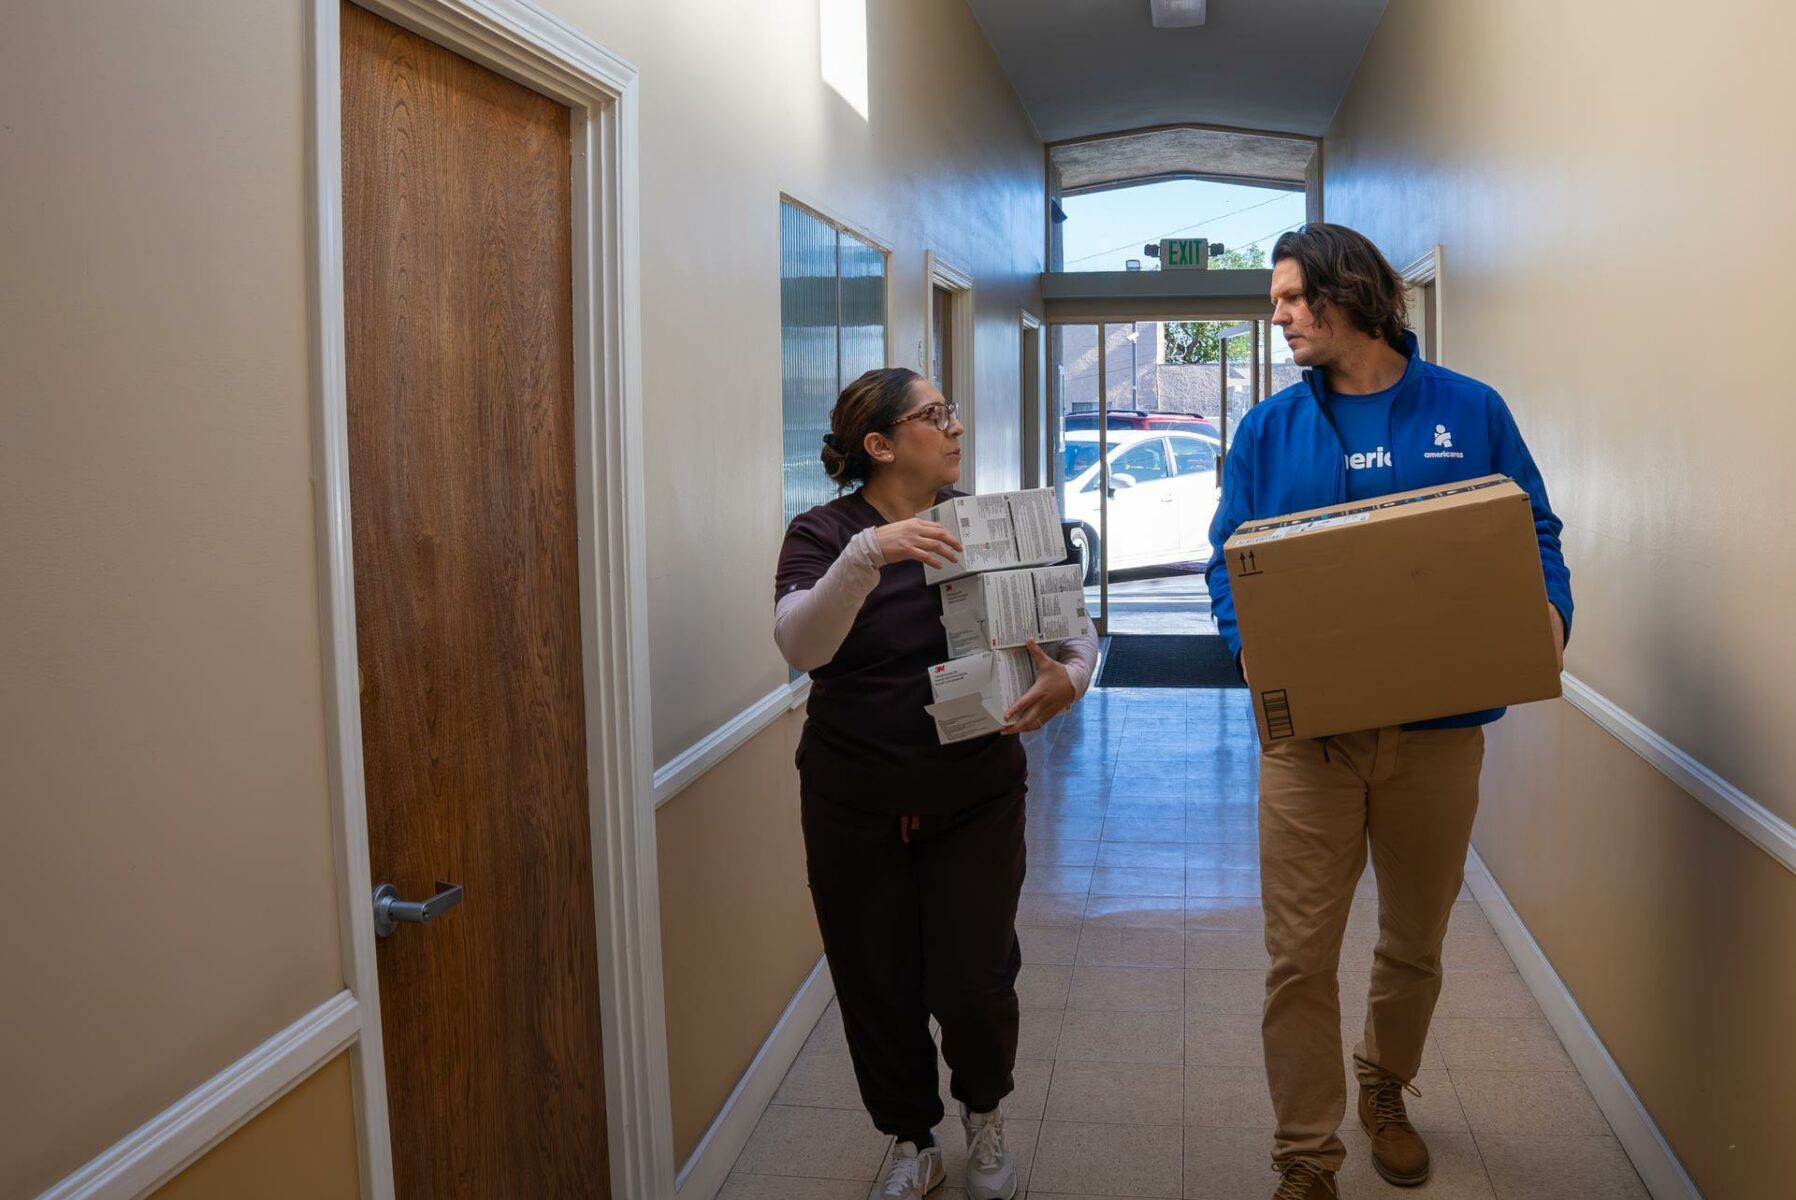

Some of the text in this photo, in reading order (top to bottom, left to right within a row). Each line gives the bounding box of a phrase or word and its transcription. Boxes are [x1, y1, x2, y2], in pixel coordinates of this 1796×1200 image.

[1168, 239, 1202, 265] EXIT
[1424, 450, 1464, 459] americares
[934, 665, 946, 673] 3M
